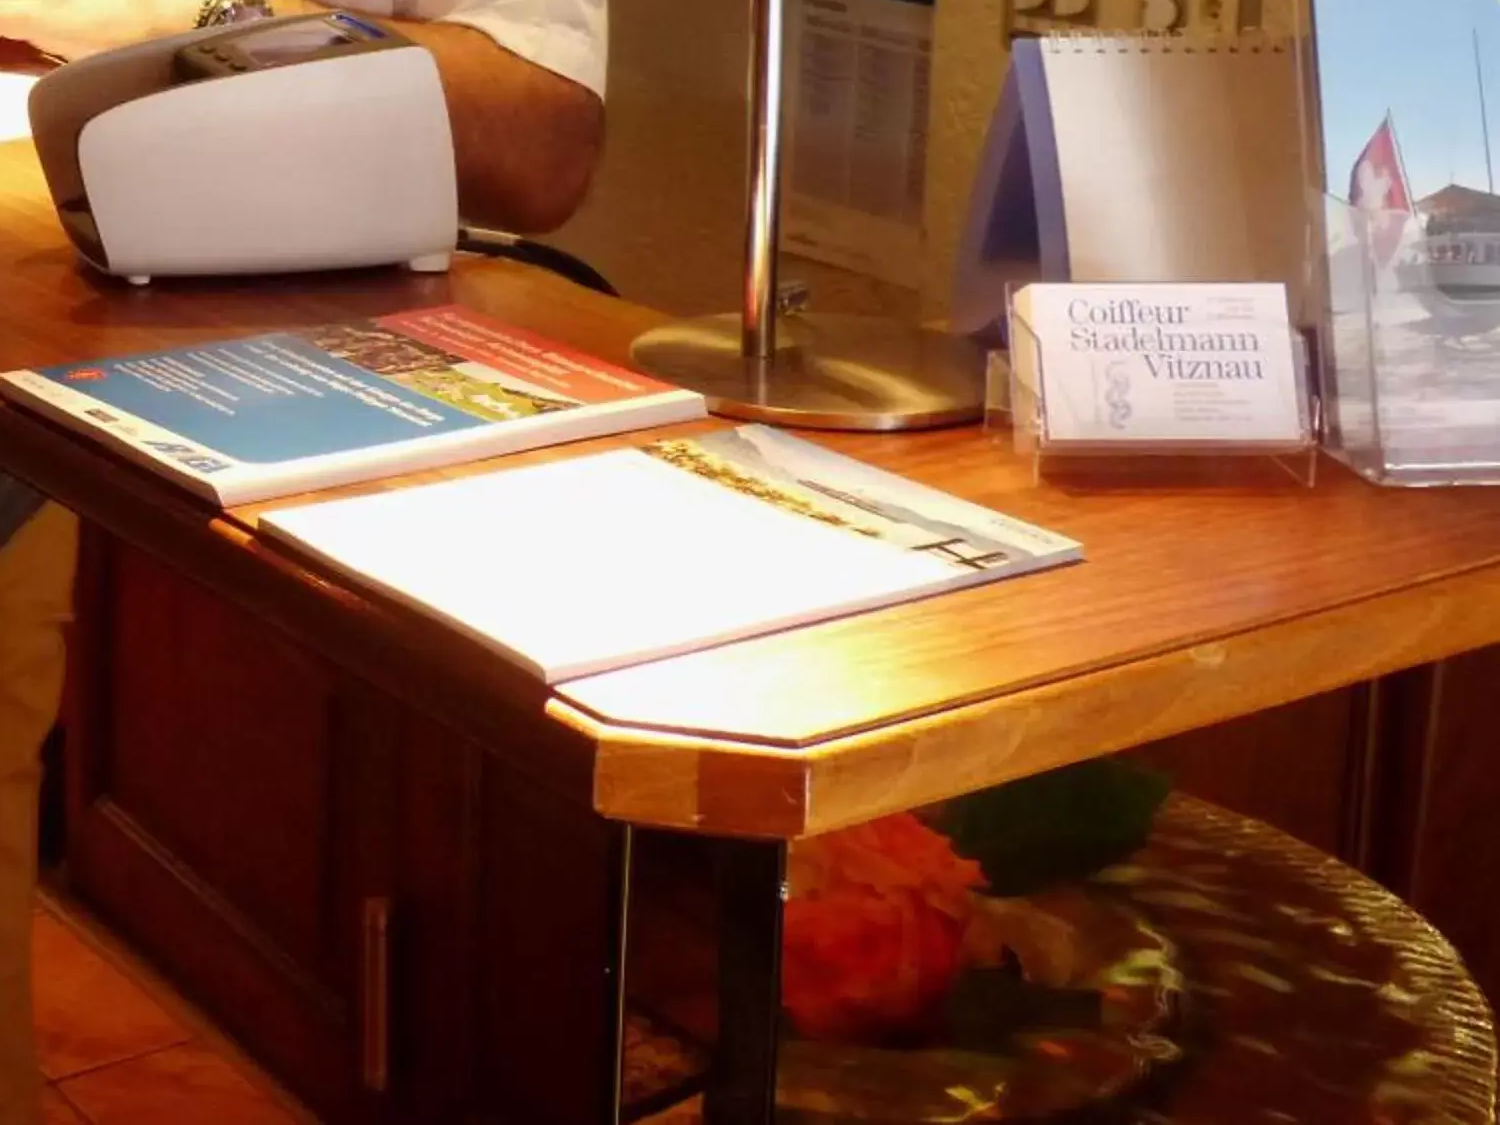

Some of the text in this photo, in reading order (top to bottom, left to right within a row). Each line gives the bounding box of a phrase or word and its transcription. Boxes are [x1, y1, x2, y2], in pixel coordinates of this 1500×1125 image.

[1068, 298, 1192, 324] Coiffeur
[1070, 326, 1260, 353] Stadelmann
[1143, 354, 1265, 380] Vitznau
